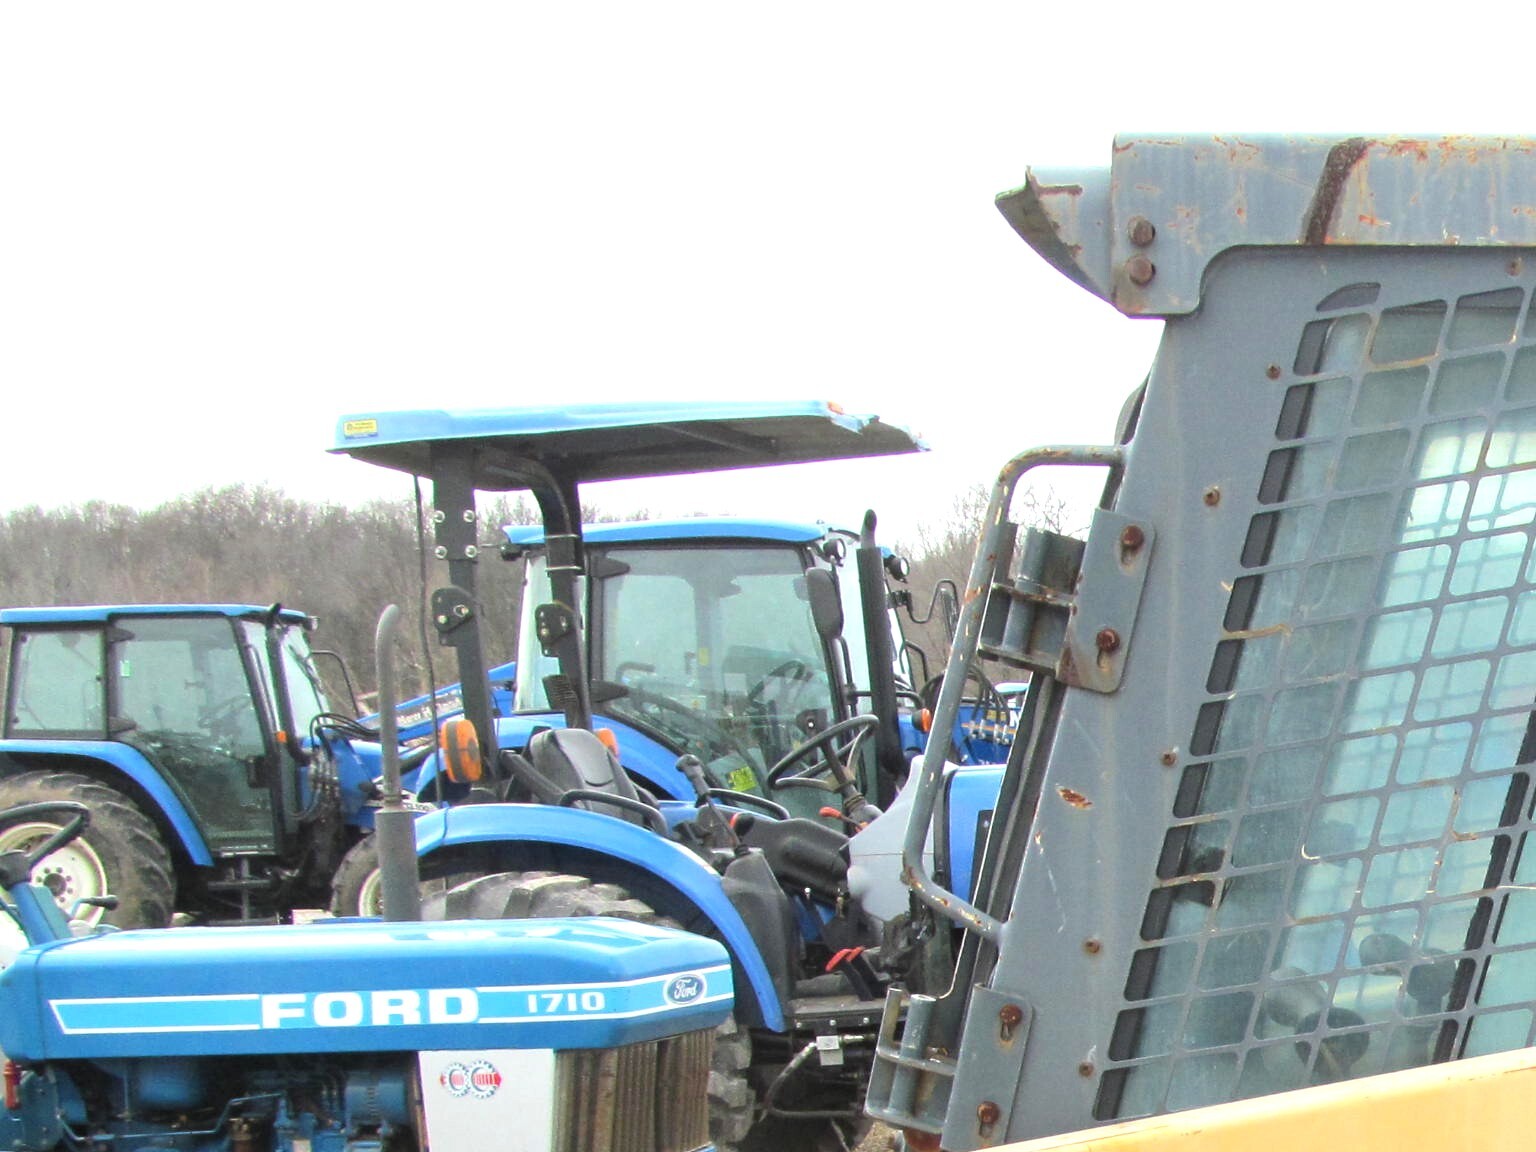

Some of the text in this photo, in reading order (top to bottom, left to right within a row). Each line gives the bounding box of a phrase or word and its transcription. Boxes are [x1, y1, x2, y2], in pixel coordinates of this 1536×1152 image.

[672, 977, 699, 1000] Ford
[261, 988, 606, 1029] FORD 1710
